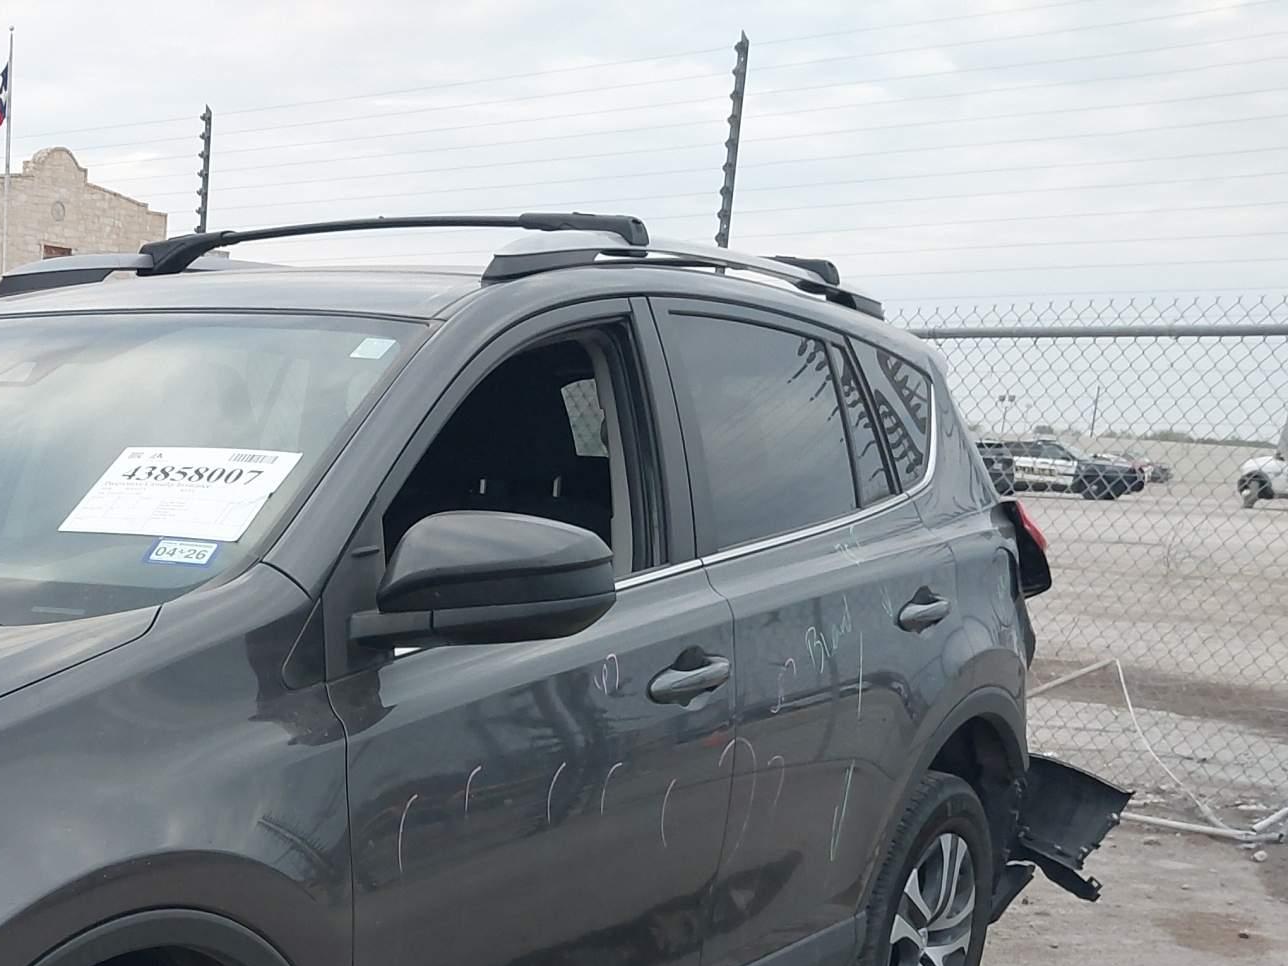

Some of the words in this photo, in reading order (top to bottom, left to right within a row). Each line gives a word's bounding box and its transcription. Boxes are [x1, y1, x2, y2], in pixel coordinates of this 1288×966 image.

[121, 465, 265, 486] 43858007
[154, 546, 178, 558] 04
[183, 548, 209, 560] 26
